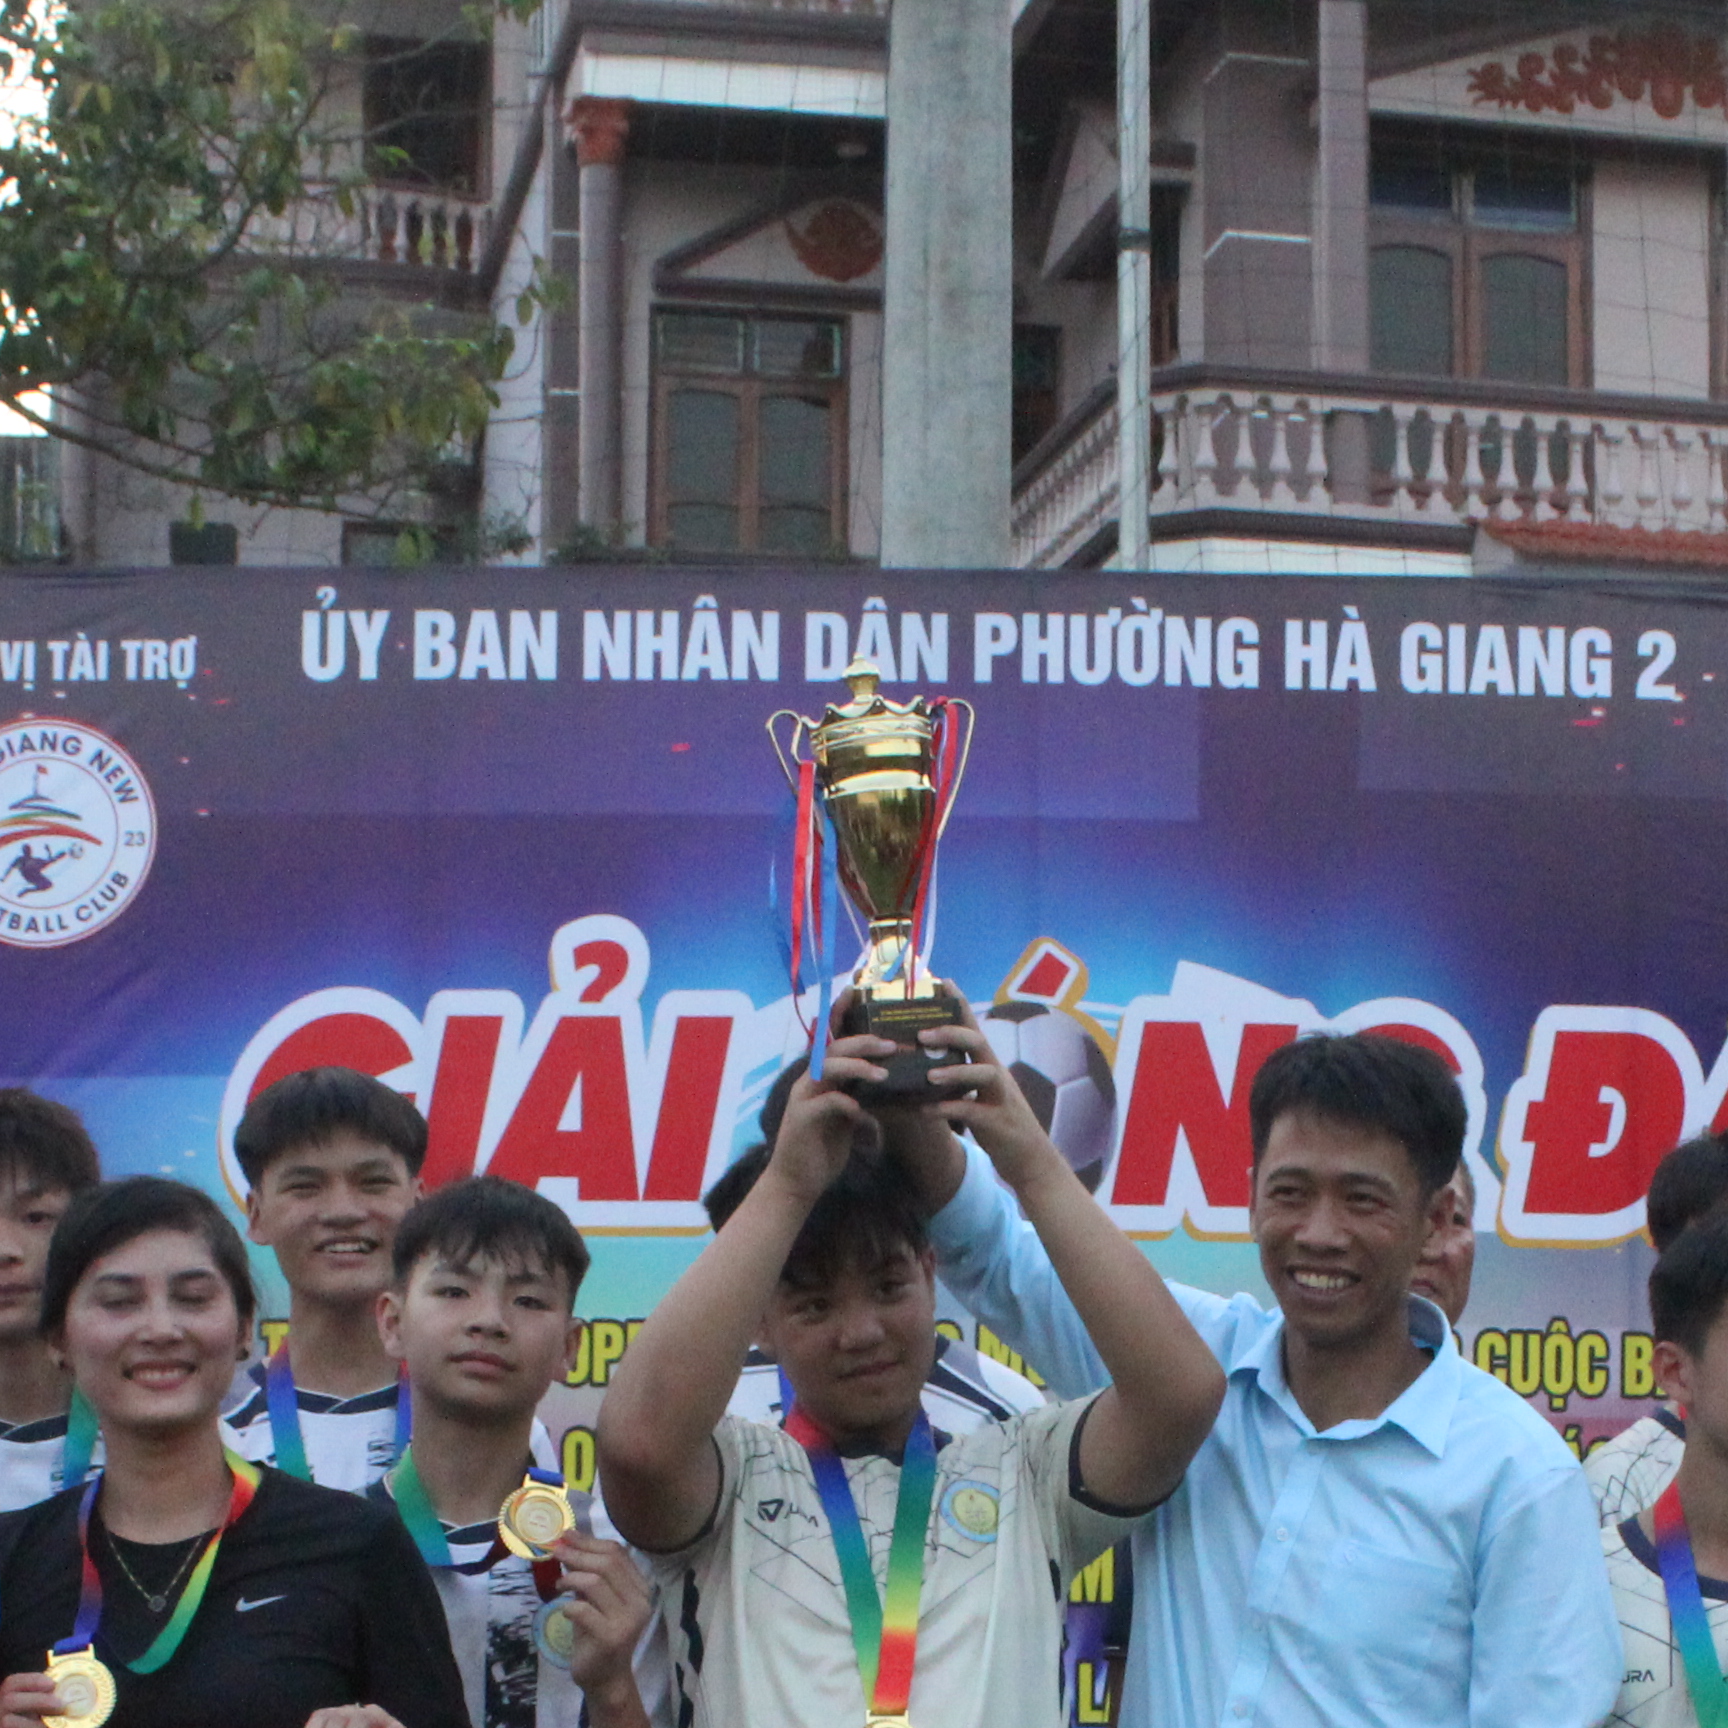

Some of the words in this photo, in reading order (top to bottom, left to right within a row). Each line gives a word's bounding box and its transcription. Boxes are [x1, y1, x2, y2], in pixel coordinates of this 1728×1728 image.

[47, 631, 110, 683] TÀI
[122, 635, 198, 690] TRỢ
[301, 586, 390, 683] ỦY
[413, 608, 558, 682] BAN
[582, 595, 780, 683] NHÂN
[804, 596, 949, 684] DÂN
[973, 597, 1260, 689] PHƯỜNG
[1284, 606, 1376, 694] HÀ
[1400, 621, 1613, 699] GIANG
[1635, 629, 1682, 701] 2
[88, 749, 140, 804] NEW
[124, 831, 146, 847] 23
[75, 871, 130, 922] CLUB
[1474, 1317, 1609, 1411] CUỘC
